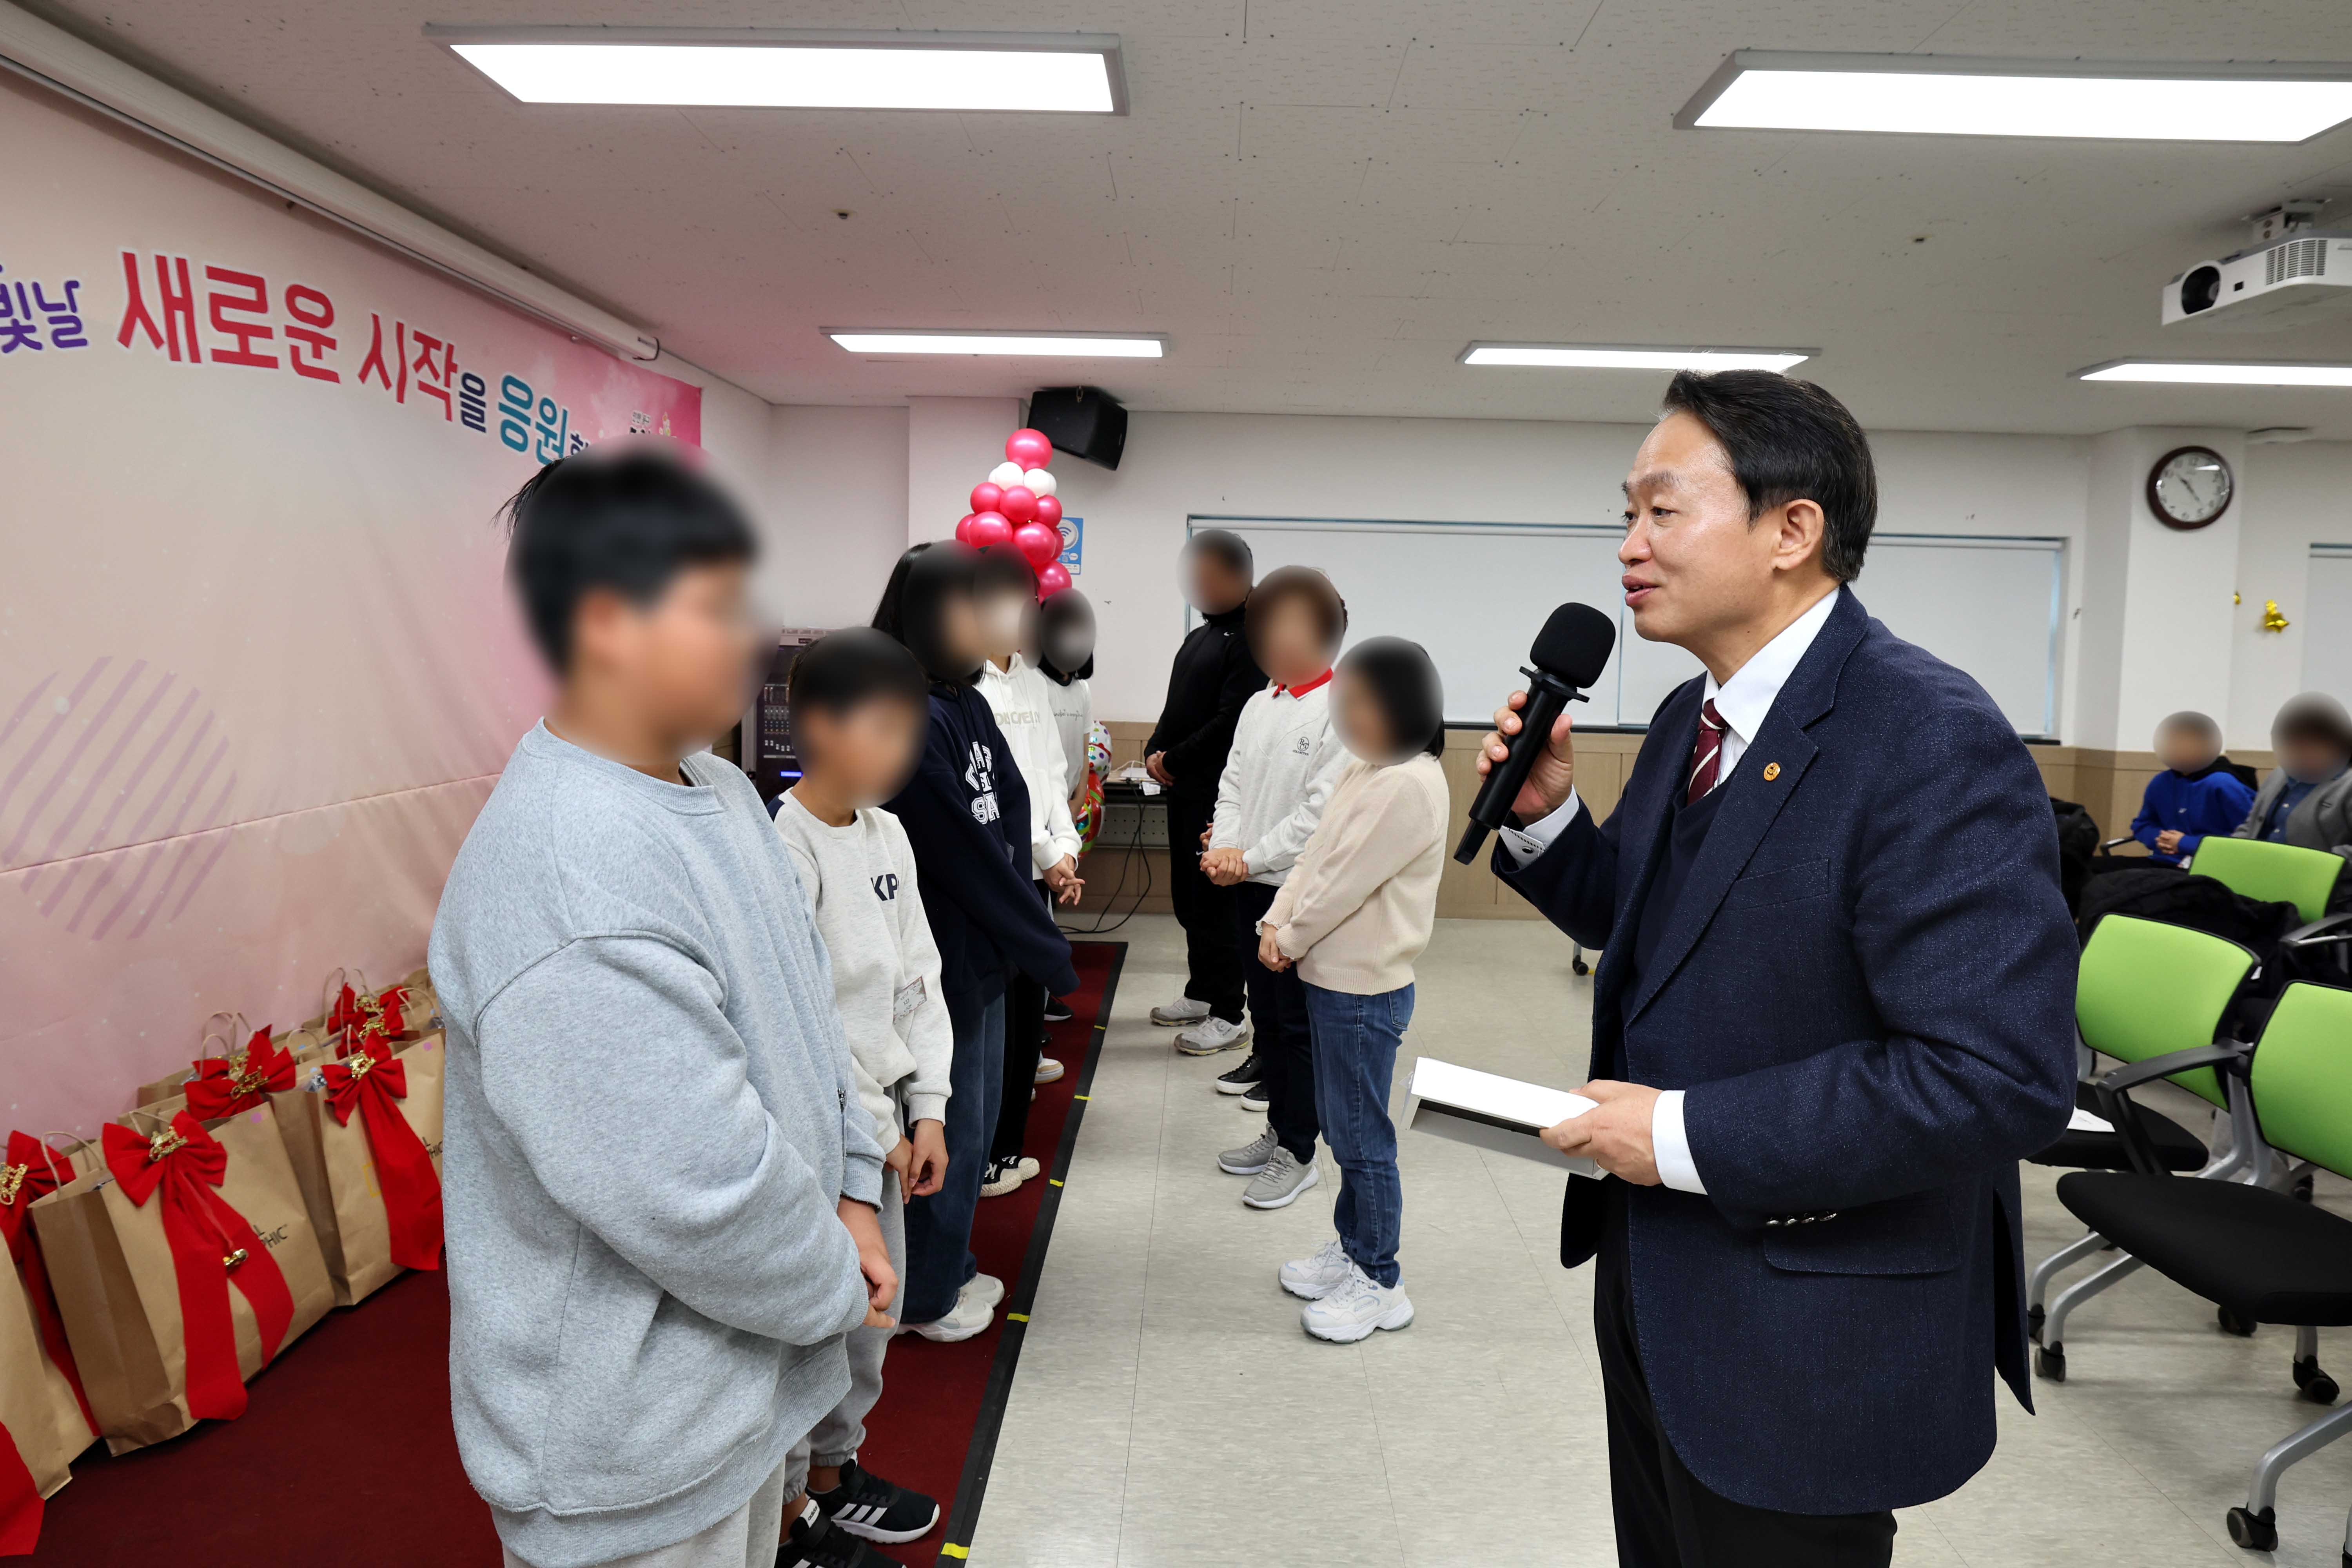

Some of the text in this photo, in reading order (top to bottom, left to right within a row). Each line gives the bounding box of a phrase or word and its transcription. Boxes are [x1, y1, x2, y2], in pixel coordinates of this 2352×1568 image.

[118, 252, 340, 384] 새로운
[358, 313, 486, 433] 시작을
[808, 1505, 818, 1521] adidas
